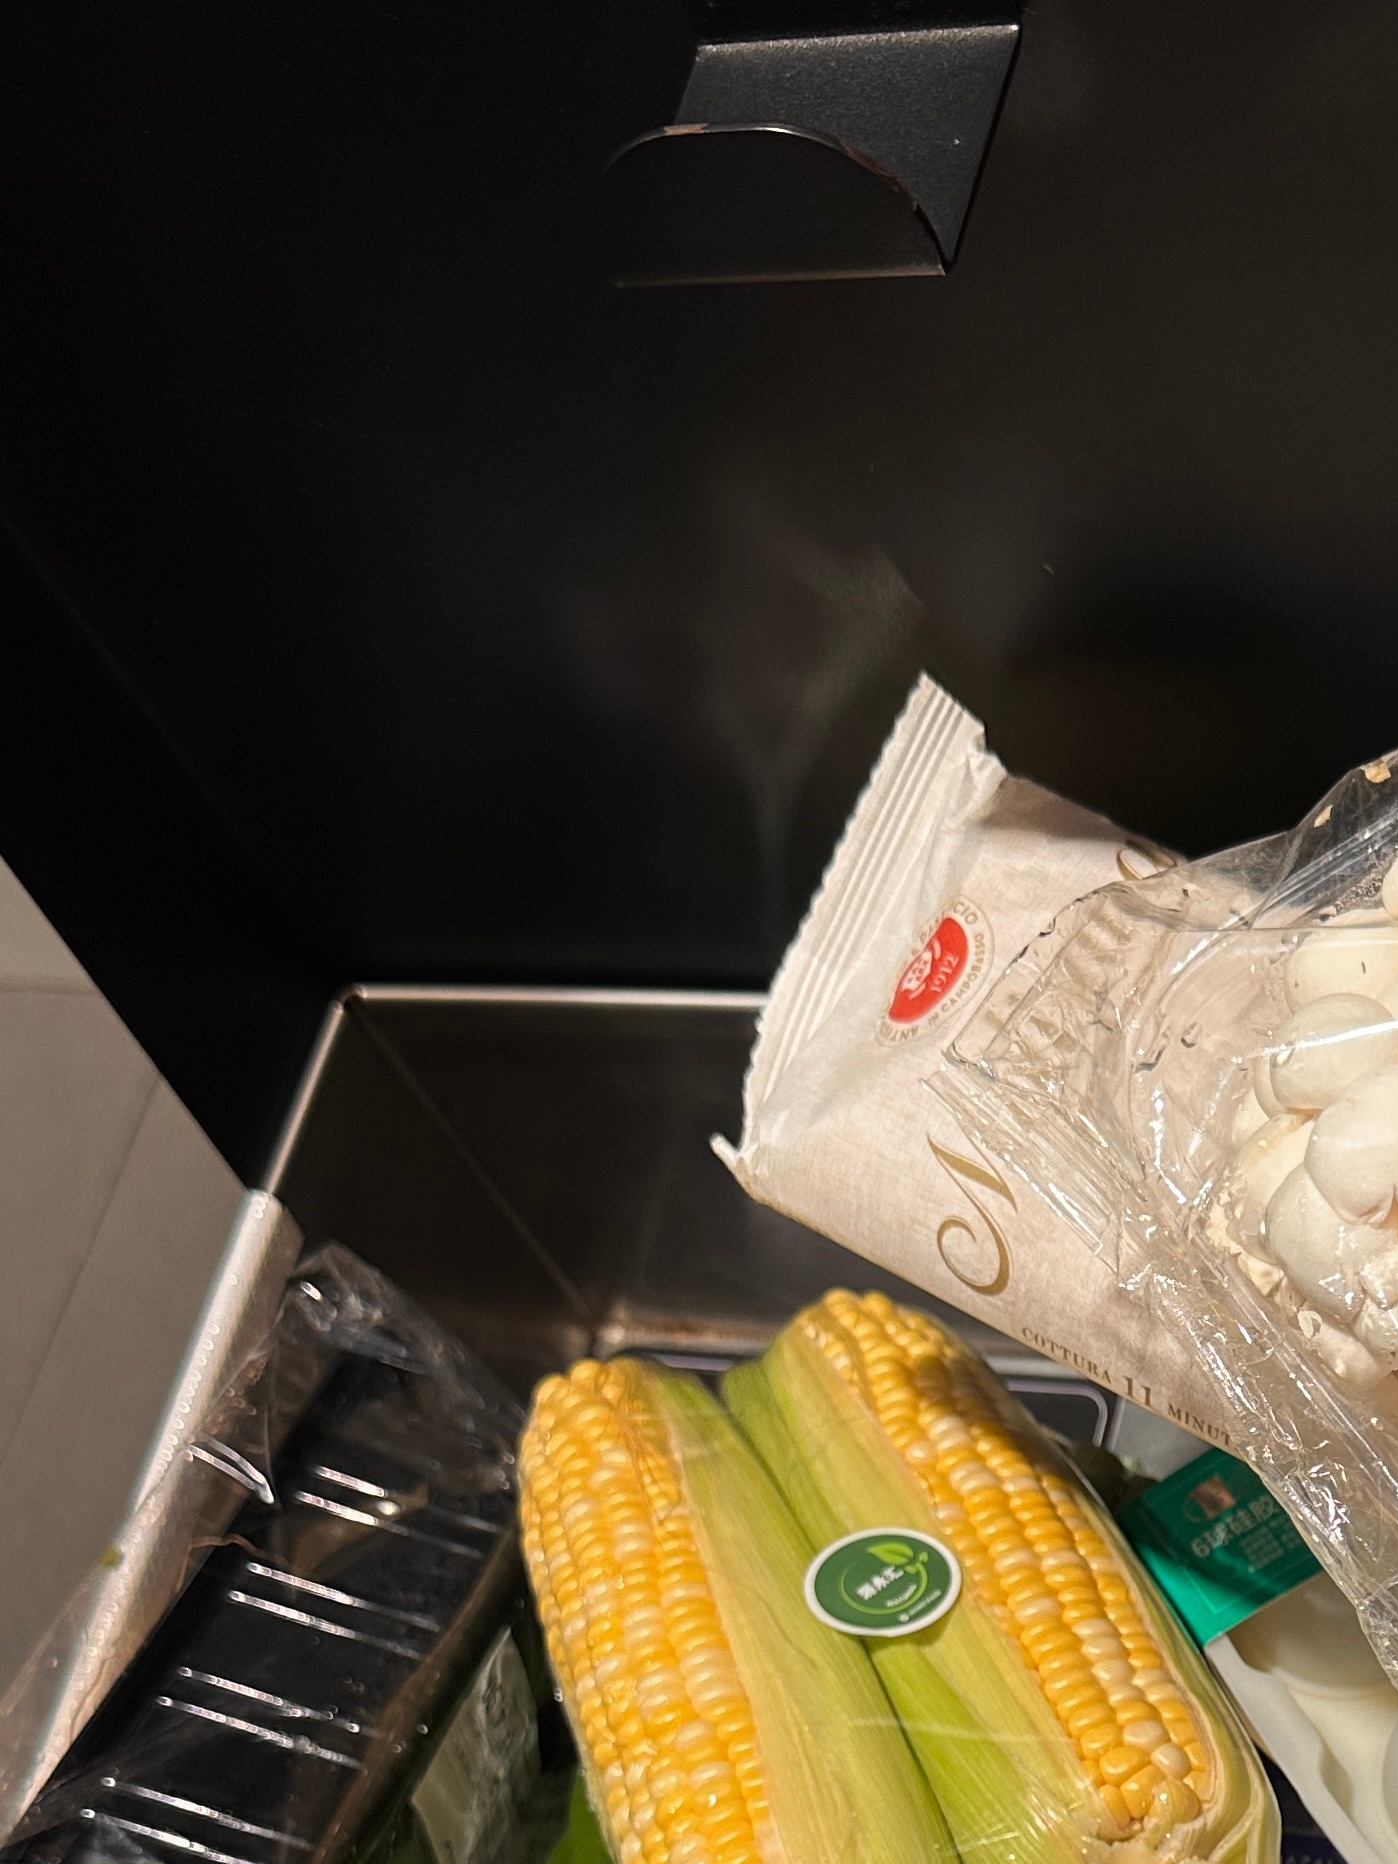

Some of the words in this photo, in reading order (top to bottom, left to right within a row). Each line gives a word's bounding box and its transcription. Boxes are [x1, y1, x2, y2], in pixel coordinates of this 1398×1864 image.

[929, 951, 960, 991] 1912
[1019, 1325, 1114, 1384] COTTURA
[1117, 1374, 1156, 1407] 11
[1163, 1403, 1238, 1451] MINUT
